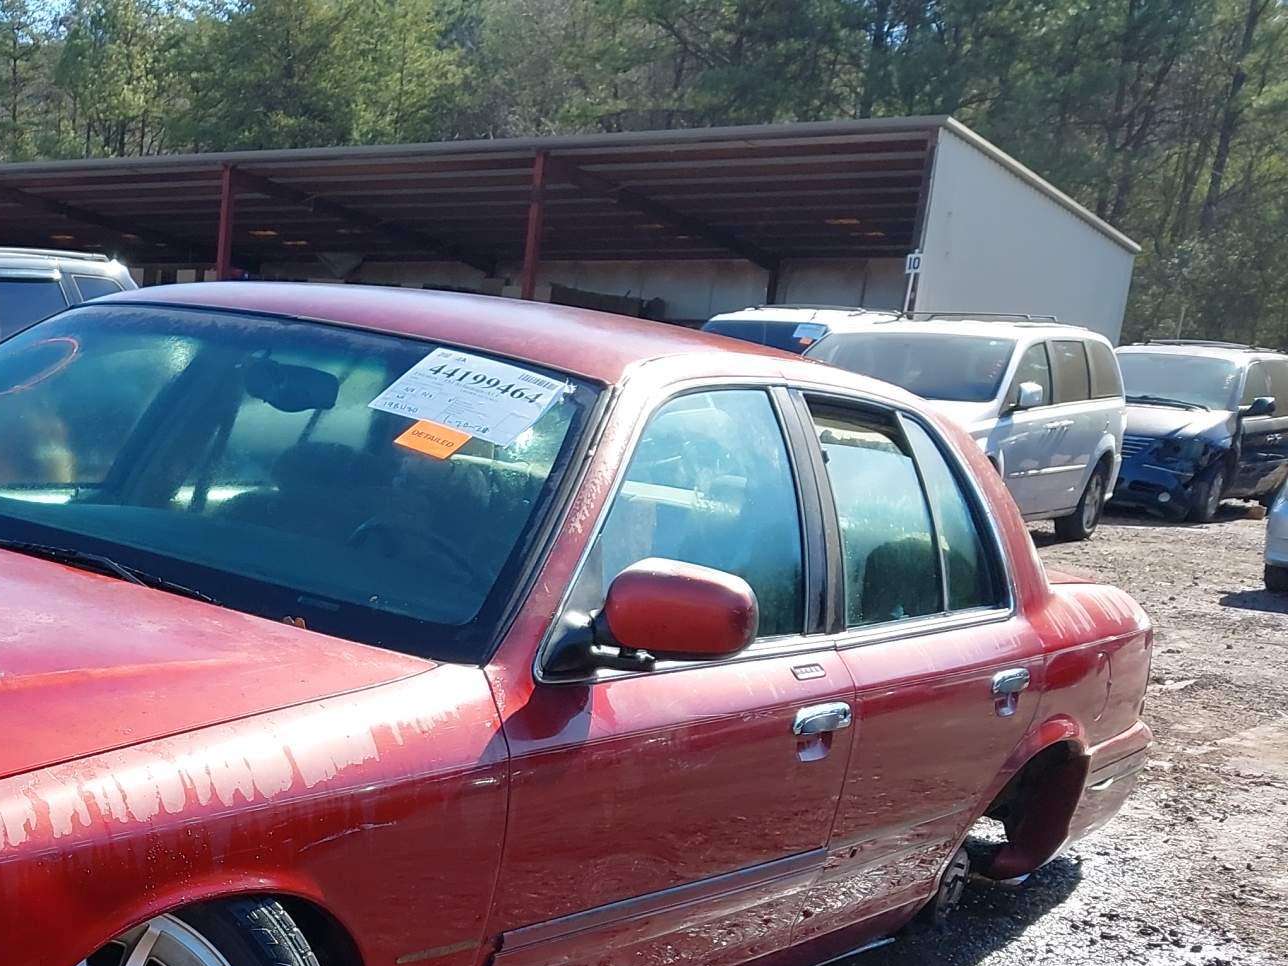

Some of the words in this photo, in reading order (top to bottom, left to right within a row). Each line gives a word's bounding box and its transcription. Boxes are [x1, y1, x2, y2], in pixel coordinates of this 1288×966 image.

[908, 256, 921, 270] 10
[428, 364, 544, 403] 44199464
[411, 429, 455, 448] DETAILED
